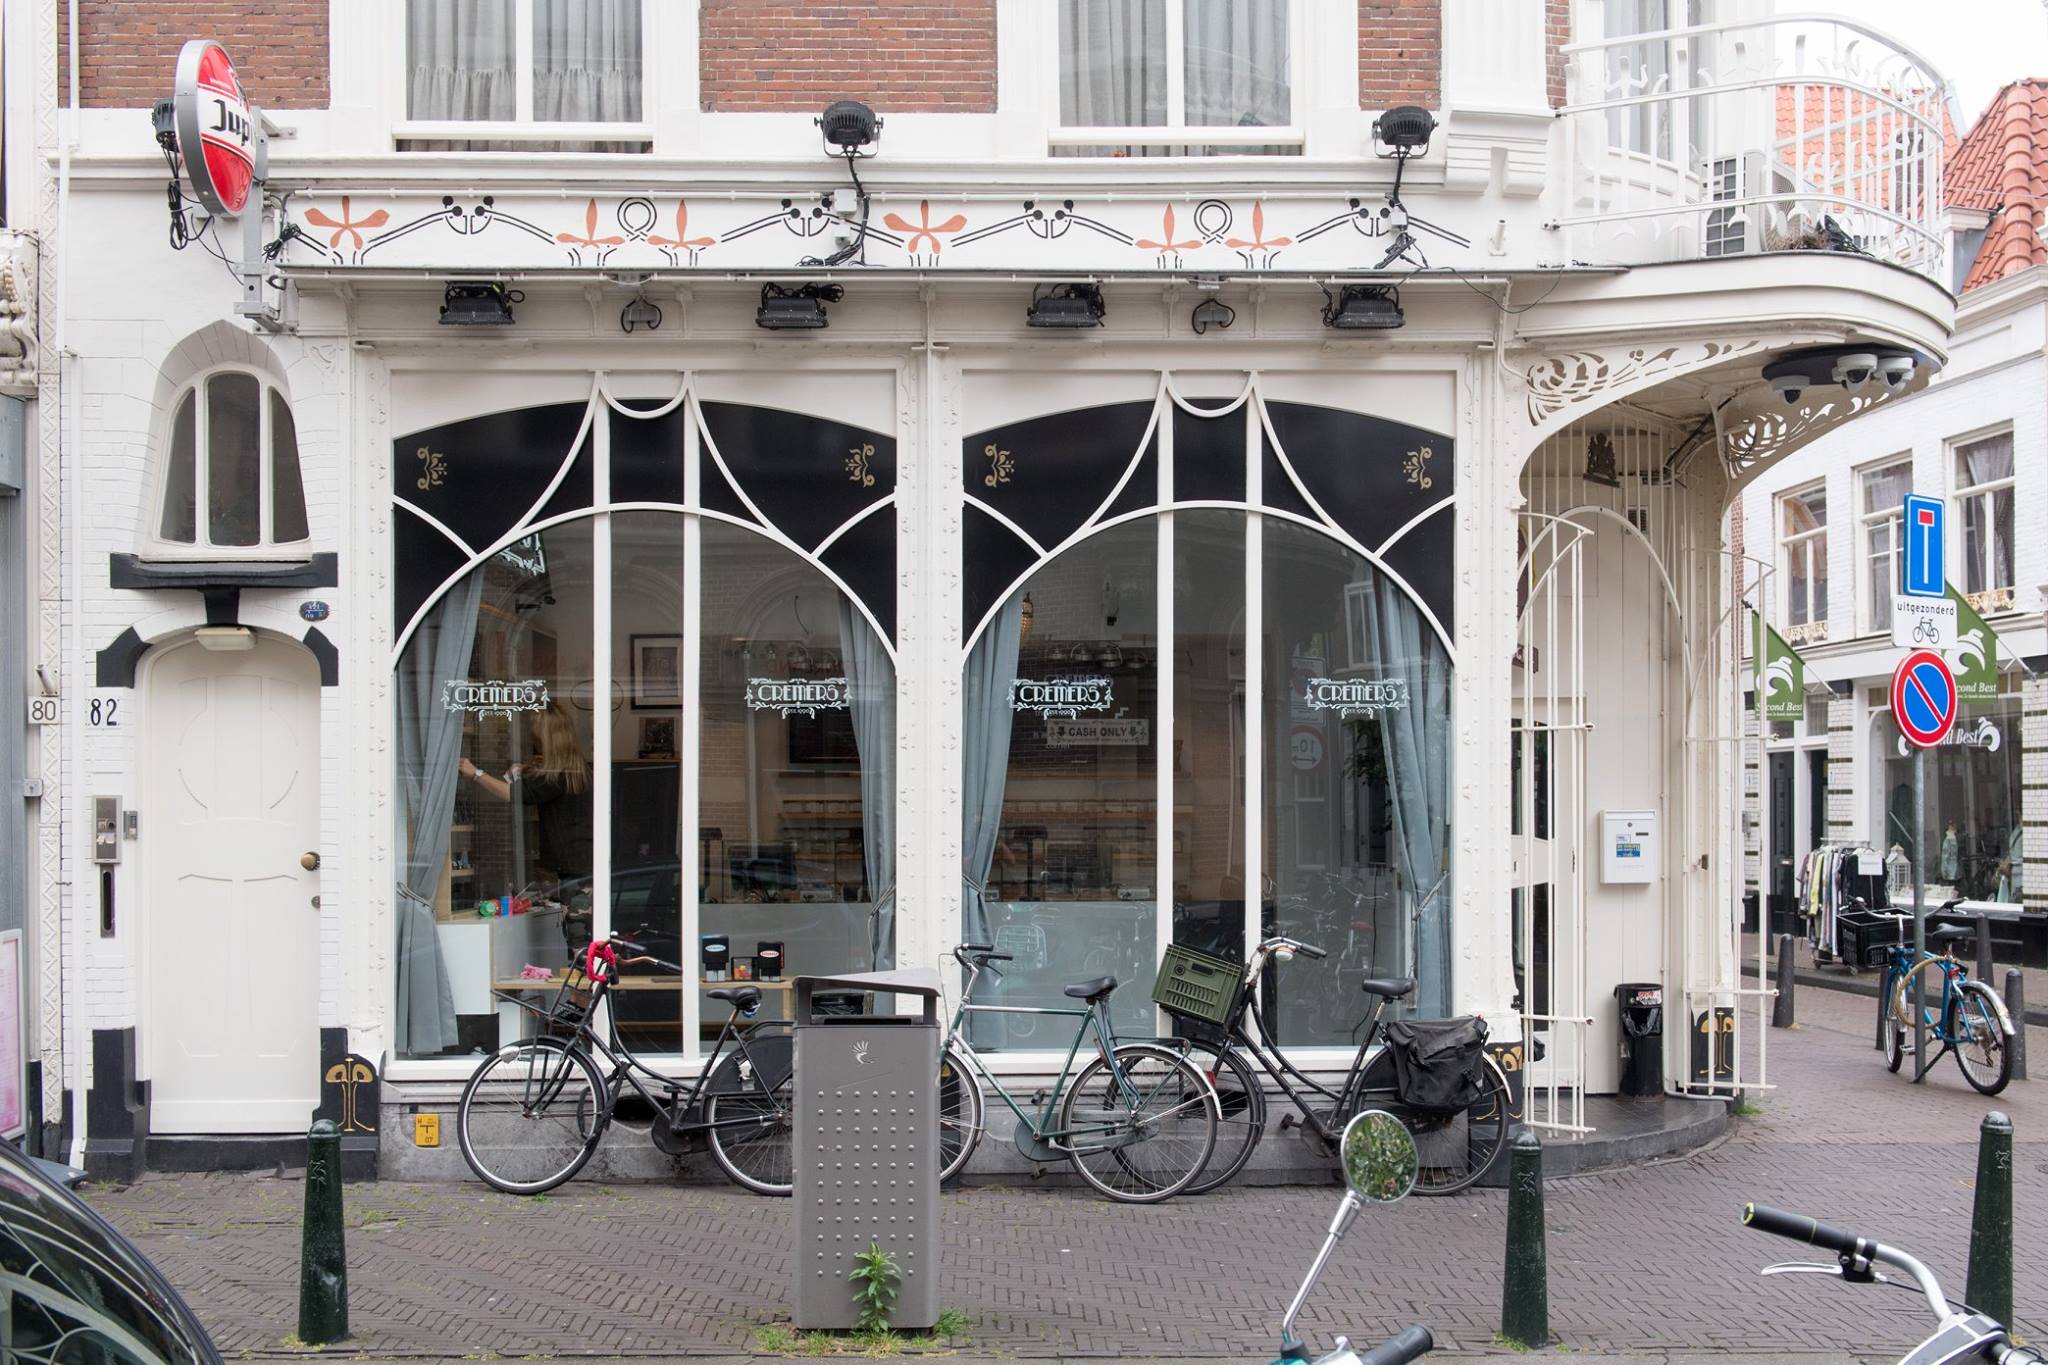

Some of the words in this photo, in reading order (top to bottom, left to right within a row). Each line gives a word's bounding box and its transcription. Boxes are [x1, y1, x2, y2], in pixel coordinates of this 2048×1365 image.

[1897, 601, 1955, 616] uitgezonderd
[454, 686, 537, 703] CREMERS
[757, 684, 839, 701] CREMERS
[1019, 685, 1101, 702] CREMERS
[1317, 684, 1398, 701] CREMERS
[1978, 682, 1997, 693] Best
[31, 700, 56, 721] 80
[90, 698, 118, 726] 82
[1755, 702, 1785, 711] Scond
[1068, 727, 1097, 737] CASH
[1100, 727, 1127, 737] ONLY
[1955, 728, 1979, 745] Best
